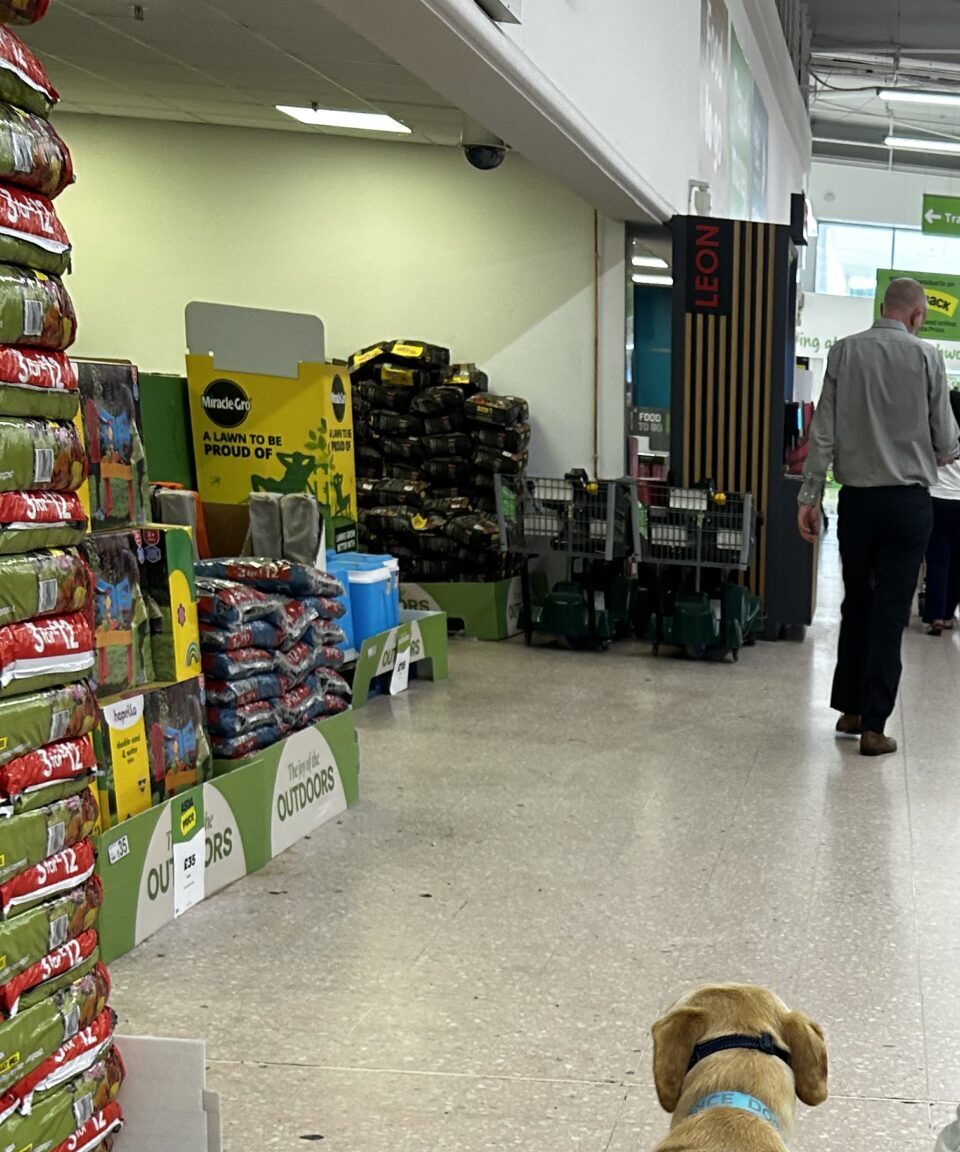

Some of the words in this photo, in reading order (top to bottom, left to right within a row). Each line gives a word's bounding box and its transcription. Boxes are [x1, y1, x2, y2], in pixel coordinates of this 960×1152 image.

[695, 224, 719, 308] LEON
[639, 412, 662, 423] FOOD
[203, 431, 211, 441] A
[214, 432, 246, 444] LAWN
[250, 434, 265, 446] TO
[268, 436, 282, 446] BE
[204, 444, 251, 458] PROUD
[254, 447, 272, 460] OF
[24, 621, 45, 653] 3
[36, 748, 53, 778] 3
[277, 765, 335, 822] OUTDOORS
[183, 854, 197, 871] £35
[36, 863, 47, 885] 3
[41, 957, 52, 980] 3
